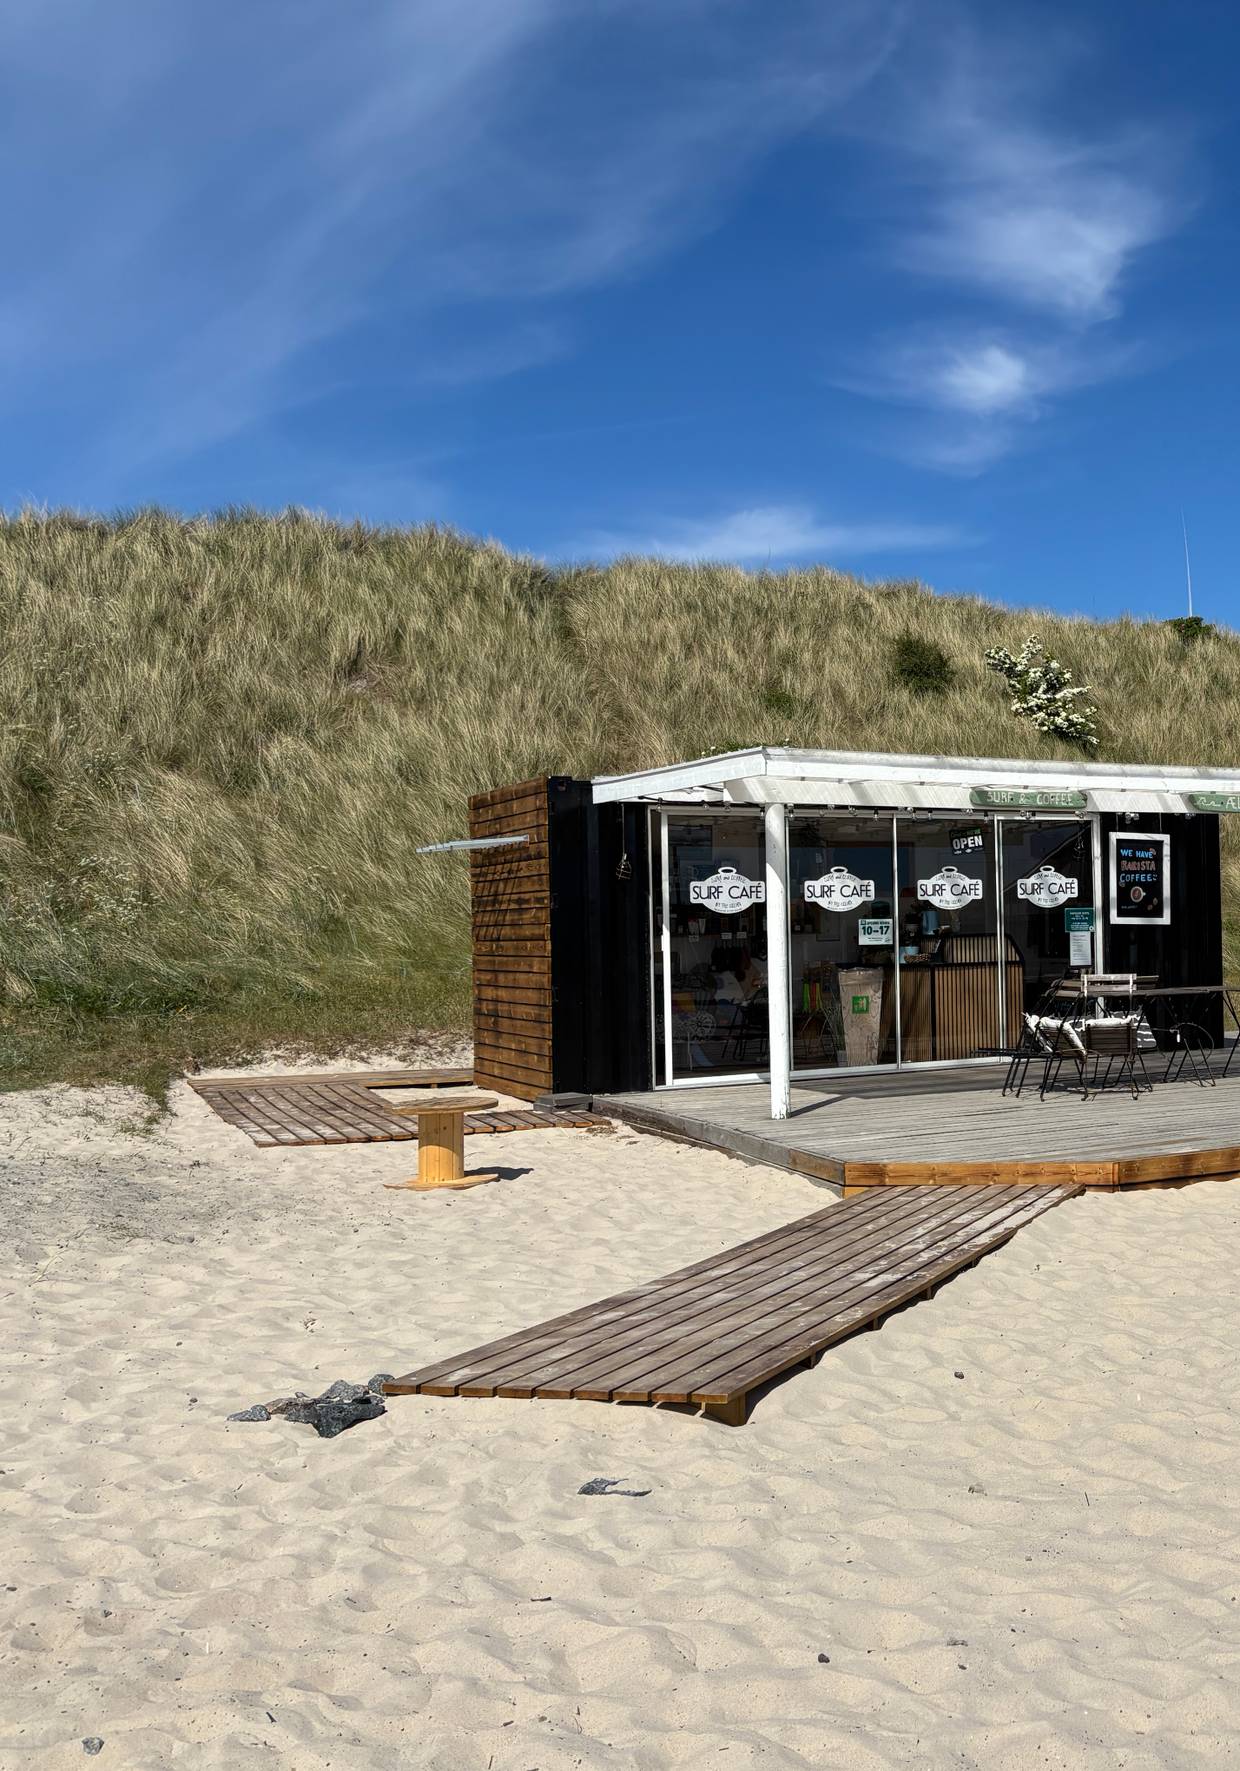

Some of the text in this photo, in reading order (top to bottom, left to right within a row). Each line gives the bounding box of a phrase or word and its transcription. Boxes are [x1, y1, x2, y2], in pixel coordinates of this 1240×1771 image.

[986, 791, 1074, 806] SURF & COFFEE
[952, 835, 983, 850] OPEN
[1120, 848, 1153, 859] WE HAVE
[1120, 860, 1156, 871] BARISTA
[1120, 873, 1153, 883] COFFEE
[692, 882, 762, 899] SURF CAFÉ
[806, 881, 872, 898] SURF CAFÉ
[919, 881, 980, 896] SURF CAFÉ
[1019, 879, 1076, 895] SURF CAFÉ
[861, 925, 890, 935] 10-17
